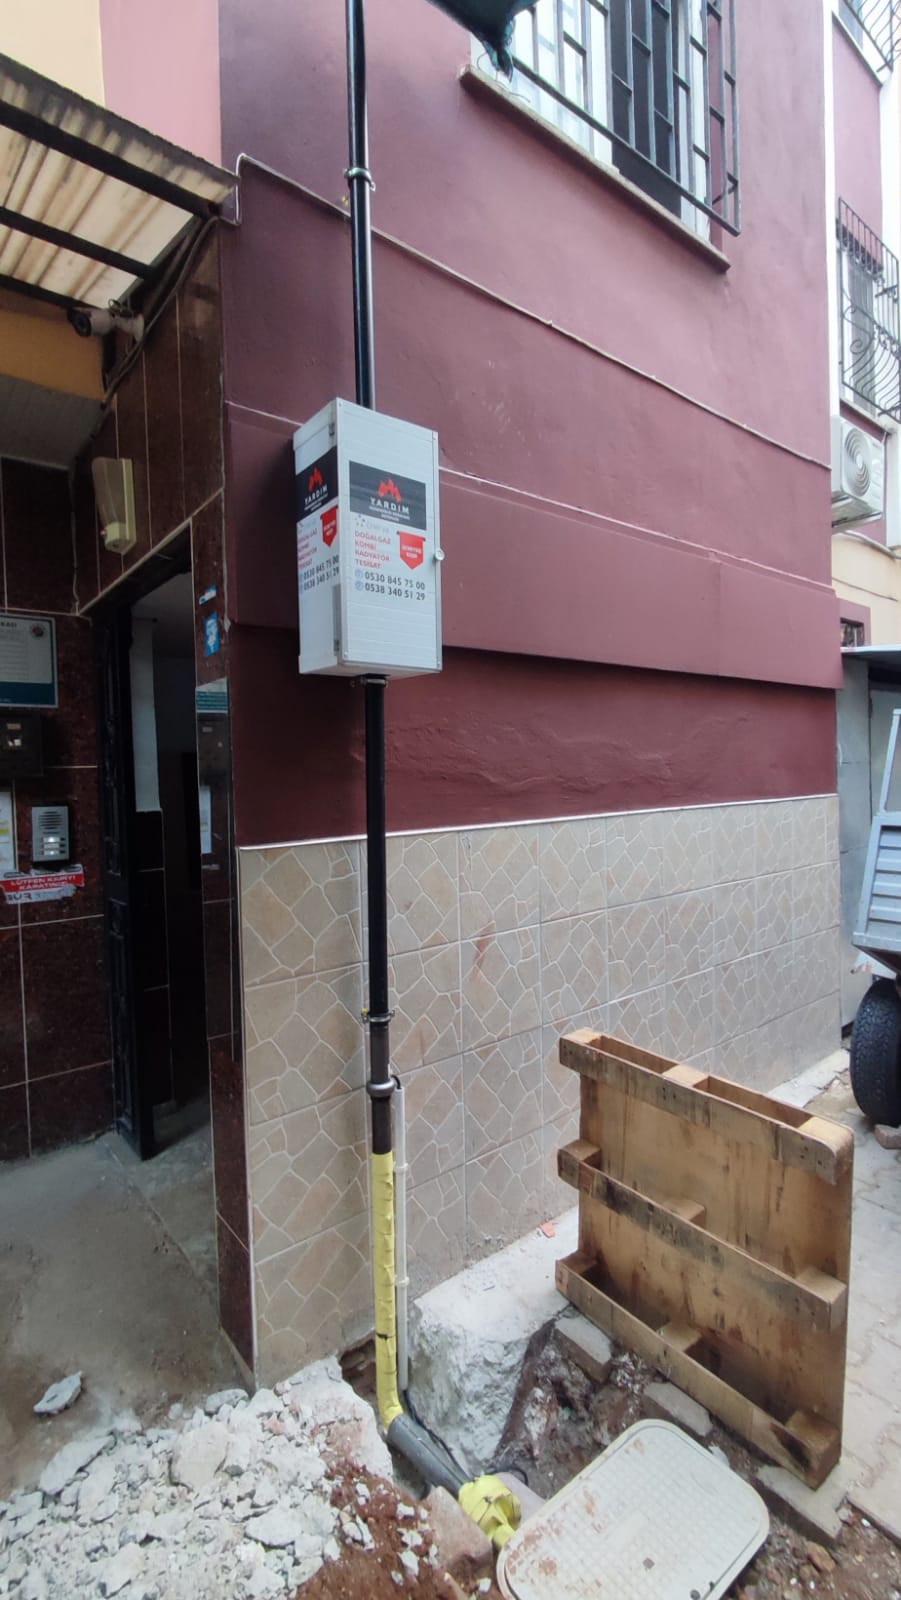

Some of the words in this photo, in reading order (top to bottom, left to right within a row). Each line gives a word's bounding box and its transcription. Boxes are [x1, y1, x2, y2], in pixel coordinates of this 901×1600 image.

[370, 496, 410, 515] YARDIM
[355, 530, 391, 545] DOĞALGAZ
[365, 571, 385, 583] 0530
[388, 575, 402, 586] 845
[405, 579, 414, 588] 75
[416, 581, 426, 591] 00
[365, 582, 385, 594] 0538
[388, 586, 403, 597] 340
[404, 590, 413, 599] 51
[416, 592, 426, 601] 29
